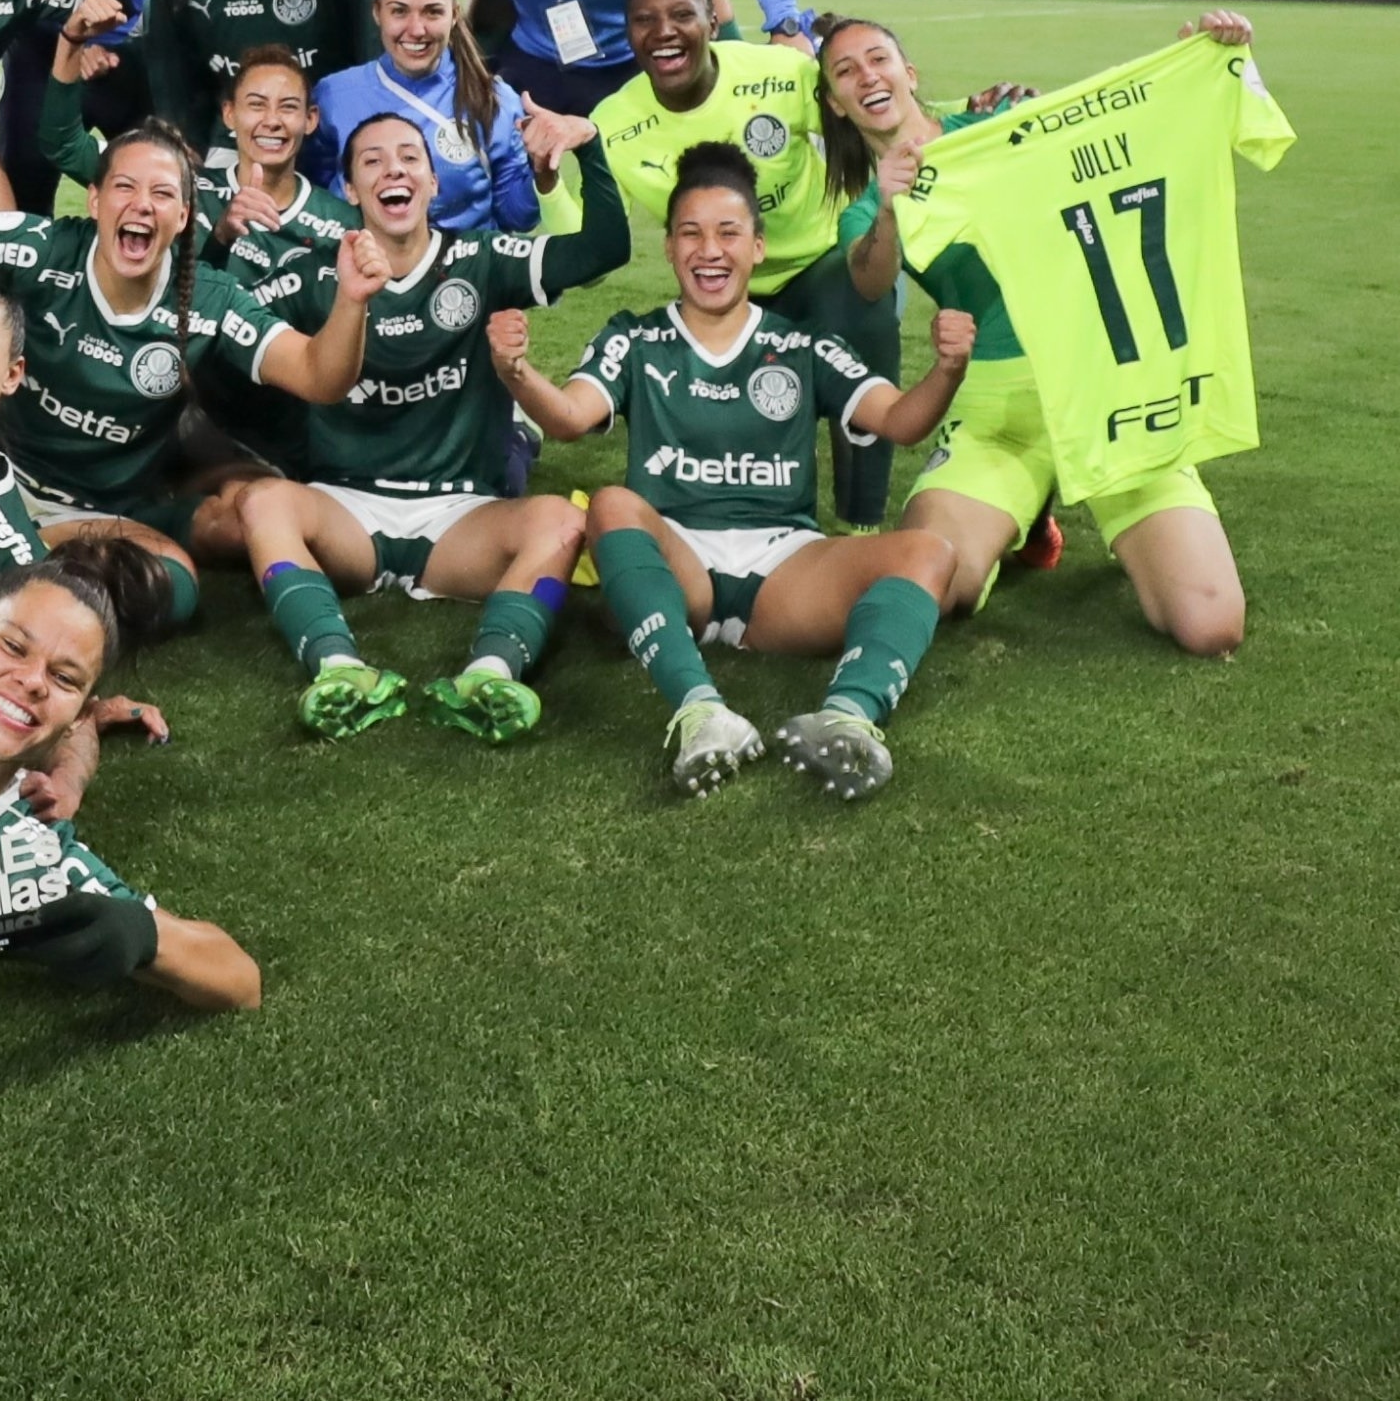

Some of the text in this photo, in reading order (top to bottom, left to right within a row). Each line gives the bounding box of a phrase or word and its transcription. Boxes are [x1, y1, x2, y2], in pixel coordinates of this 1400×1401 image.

[224, 4, 264, 17] TODOS
[732, 77, 797, 99] crefisa
[1040, 78, 1154, 136] betfair
[1069, 133, 1133, 184] JULLY
[1121, 186, 1160, 205] crefisa
[1060, 178, 1189, 366] 17
[375, 319, 424, 336] TODOS
[77, 339, 124, 367] TODOS
[379, 358, 468, 406] betfai
[689, 384, 740, 400] TODOS
[40, 388, 142, 445] betfai
[676, 448, 800, 486] betfair
